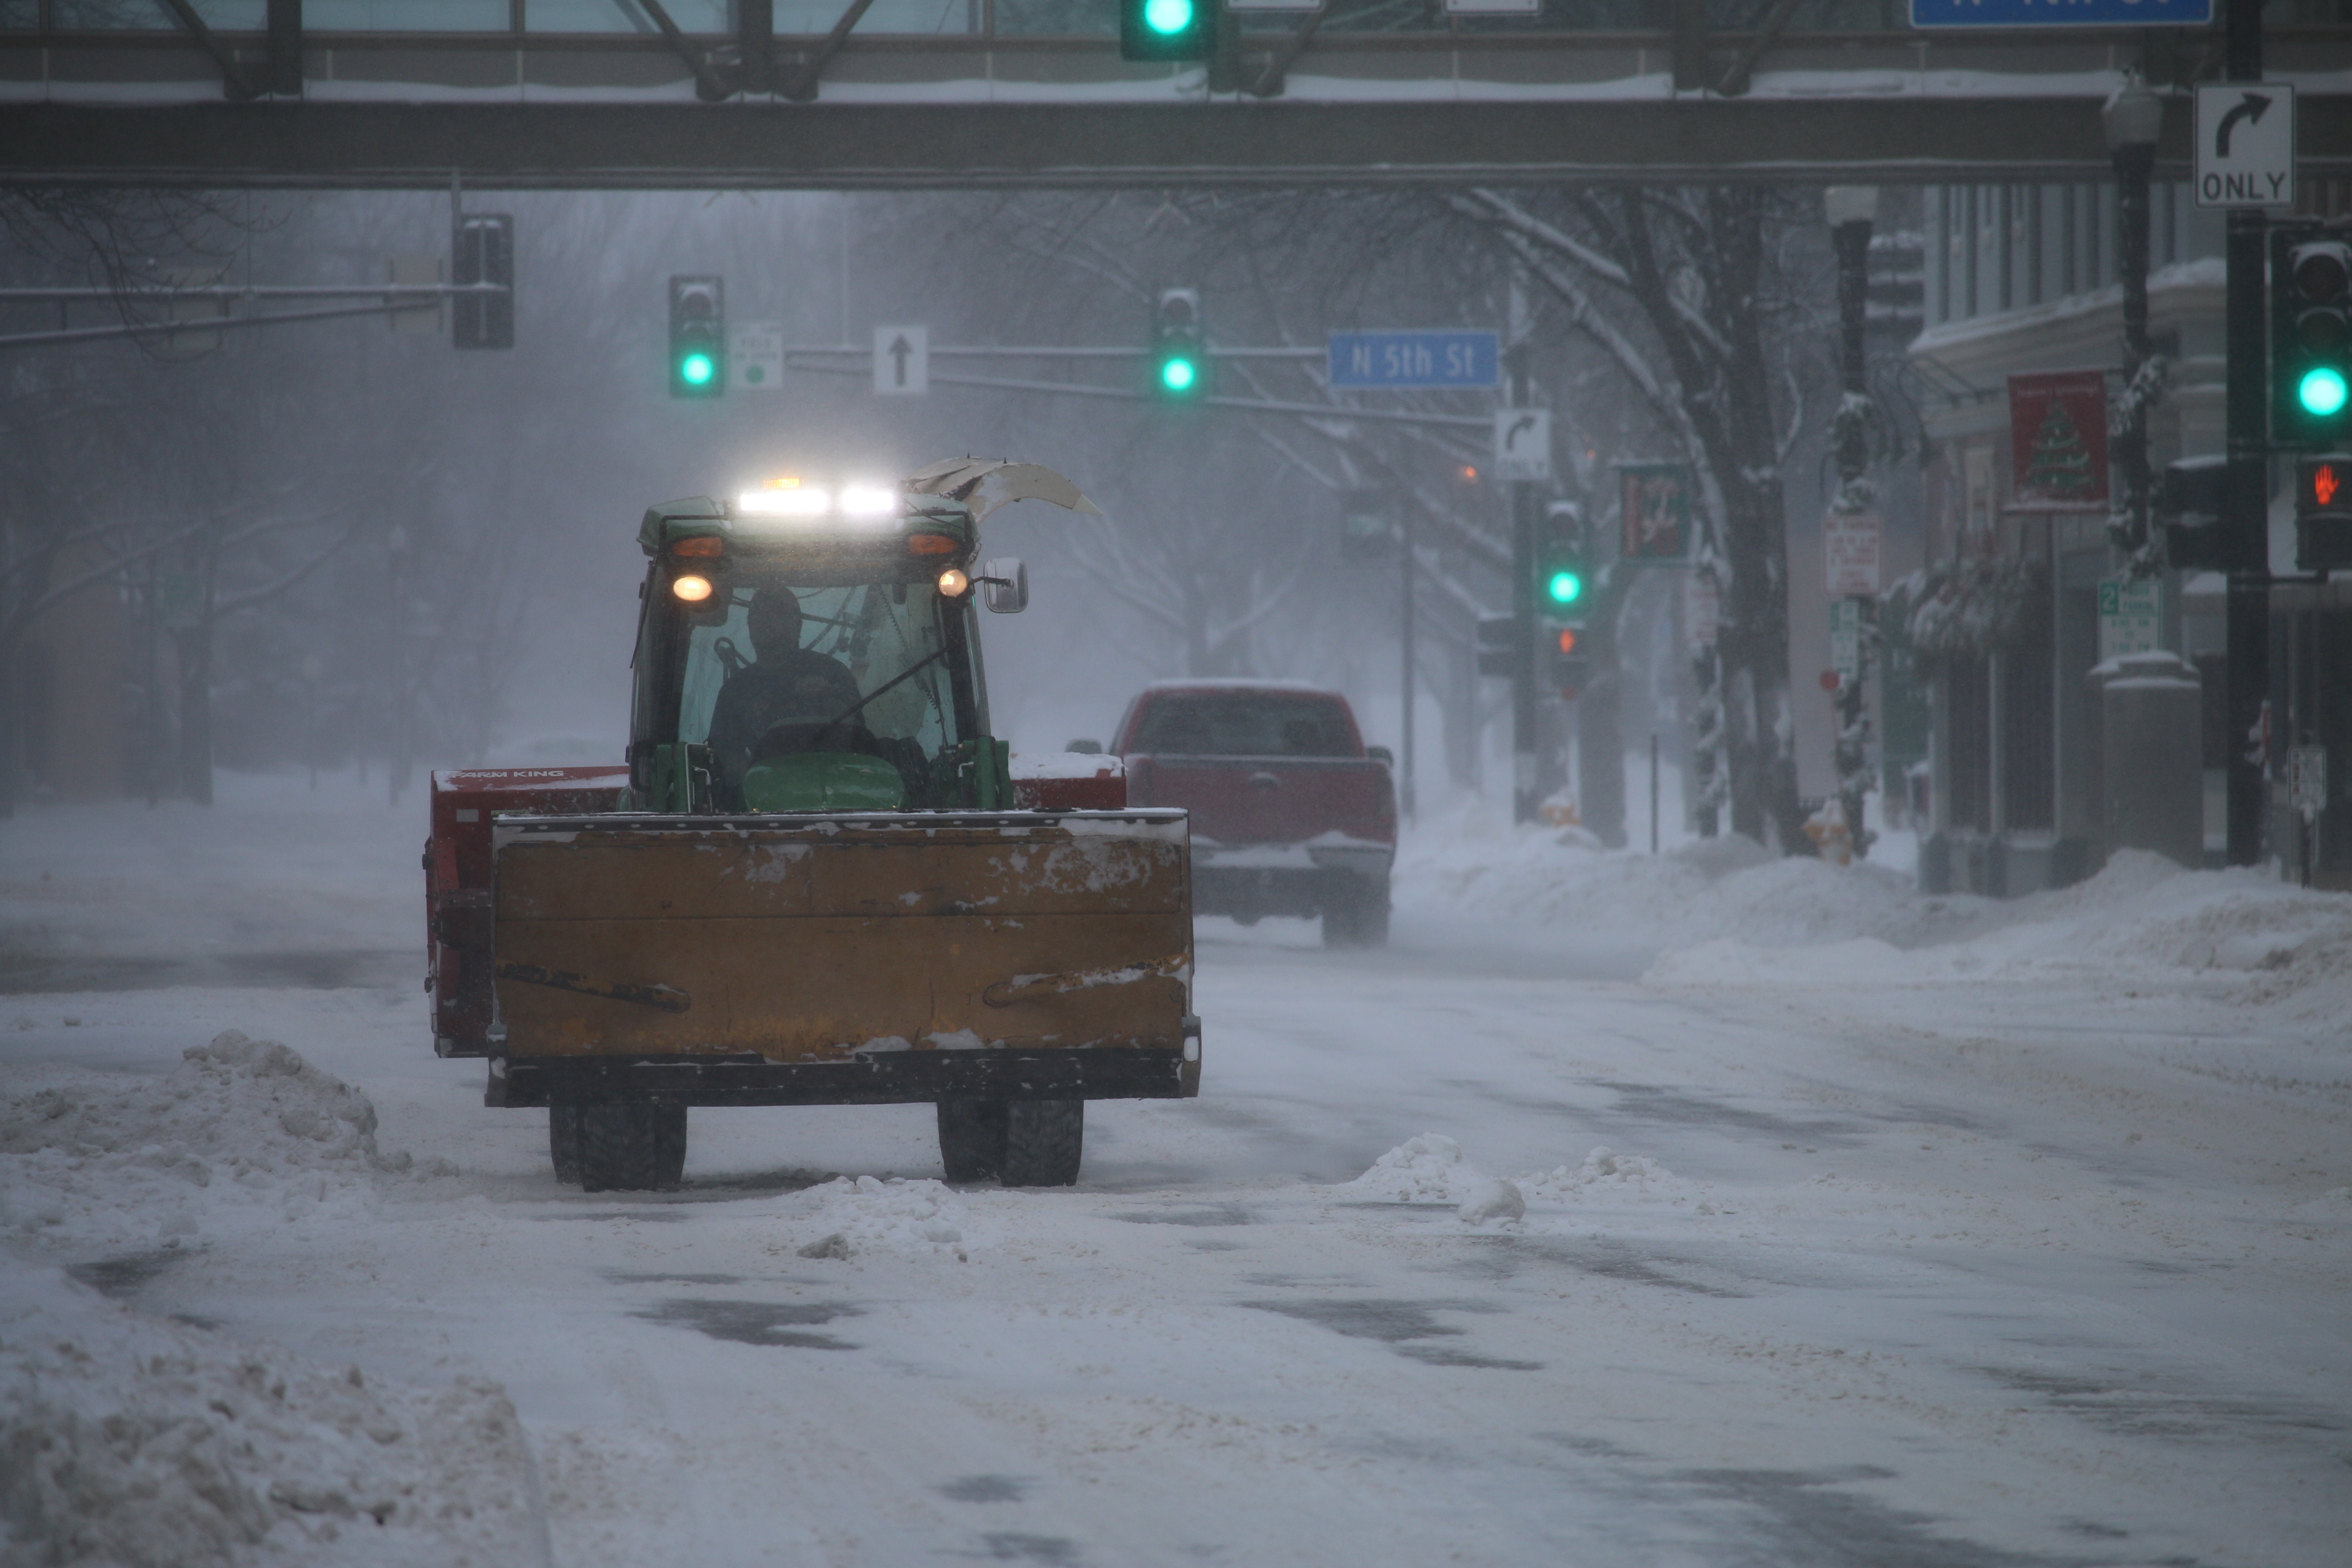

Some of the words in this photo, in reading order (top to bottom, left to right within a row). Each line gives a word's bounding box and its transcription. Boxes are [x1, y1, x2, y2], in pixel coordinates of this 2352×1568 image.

[2204, 172, 2287, 199] ONLY
[1352, 345, 1371, 377] N
[1384, 345, 1432, 378] 5th
[1446, 345, 1473, 377] St
[2102, 587, 2116, 610] 2
